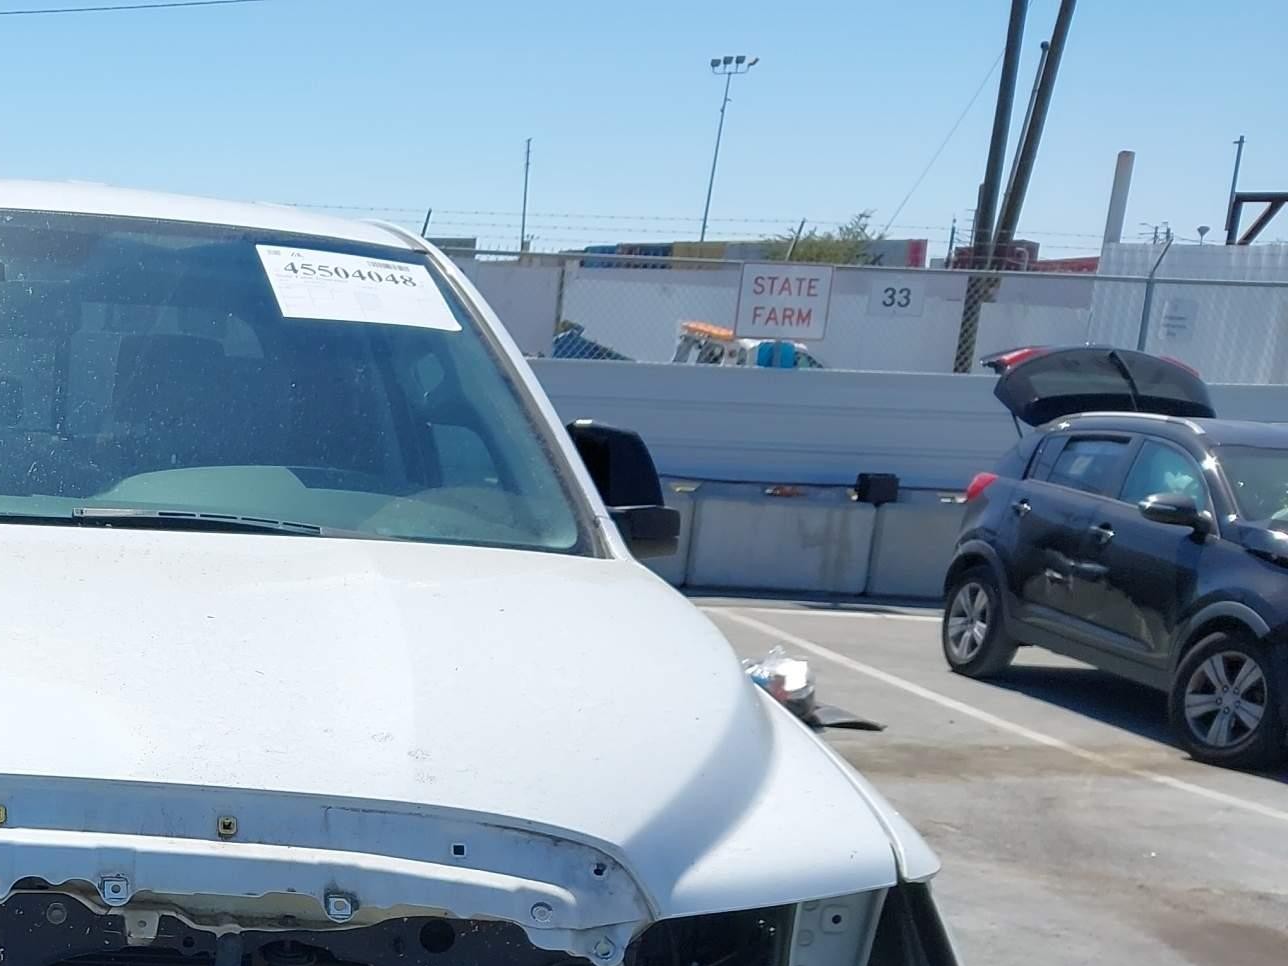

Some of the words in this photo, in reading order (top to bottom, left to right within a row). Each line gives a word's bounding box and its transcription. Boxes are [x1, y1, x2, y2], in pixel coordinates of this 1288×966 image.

[283, 261, 417, 287] 45504048
[752, 275, 820, 297] STATE
[881, 287, 912, 308] 33
[751, 306, 812, 329] FARM
